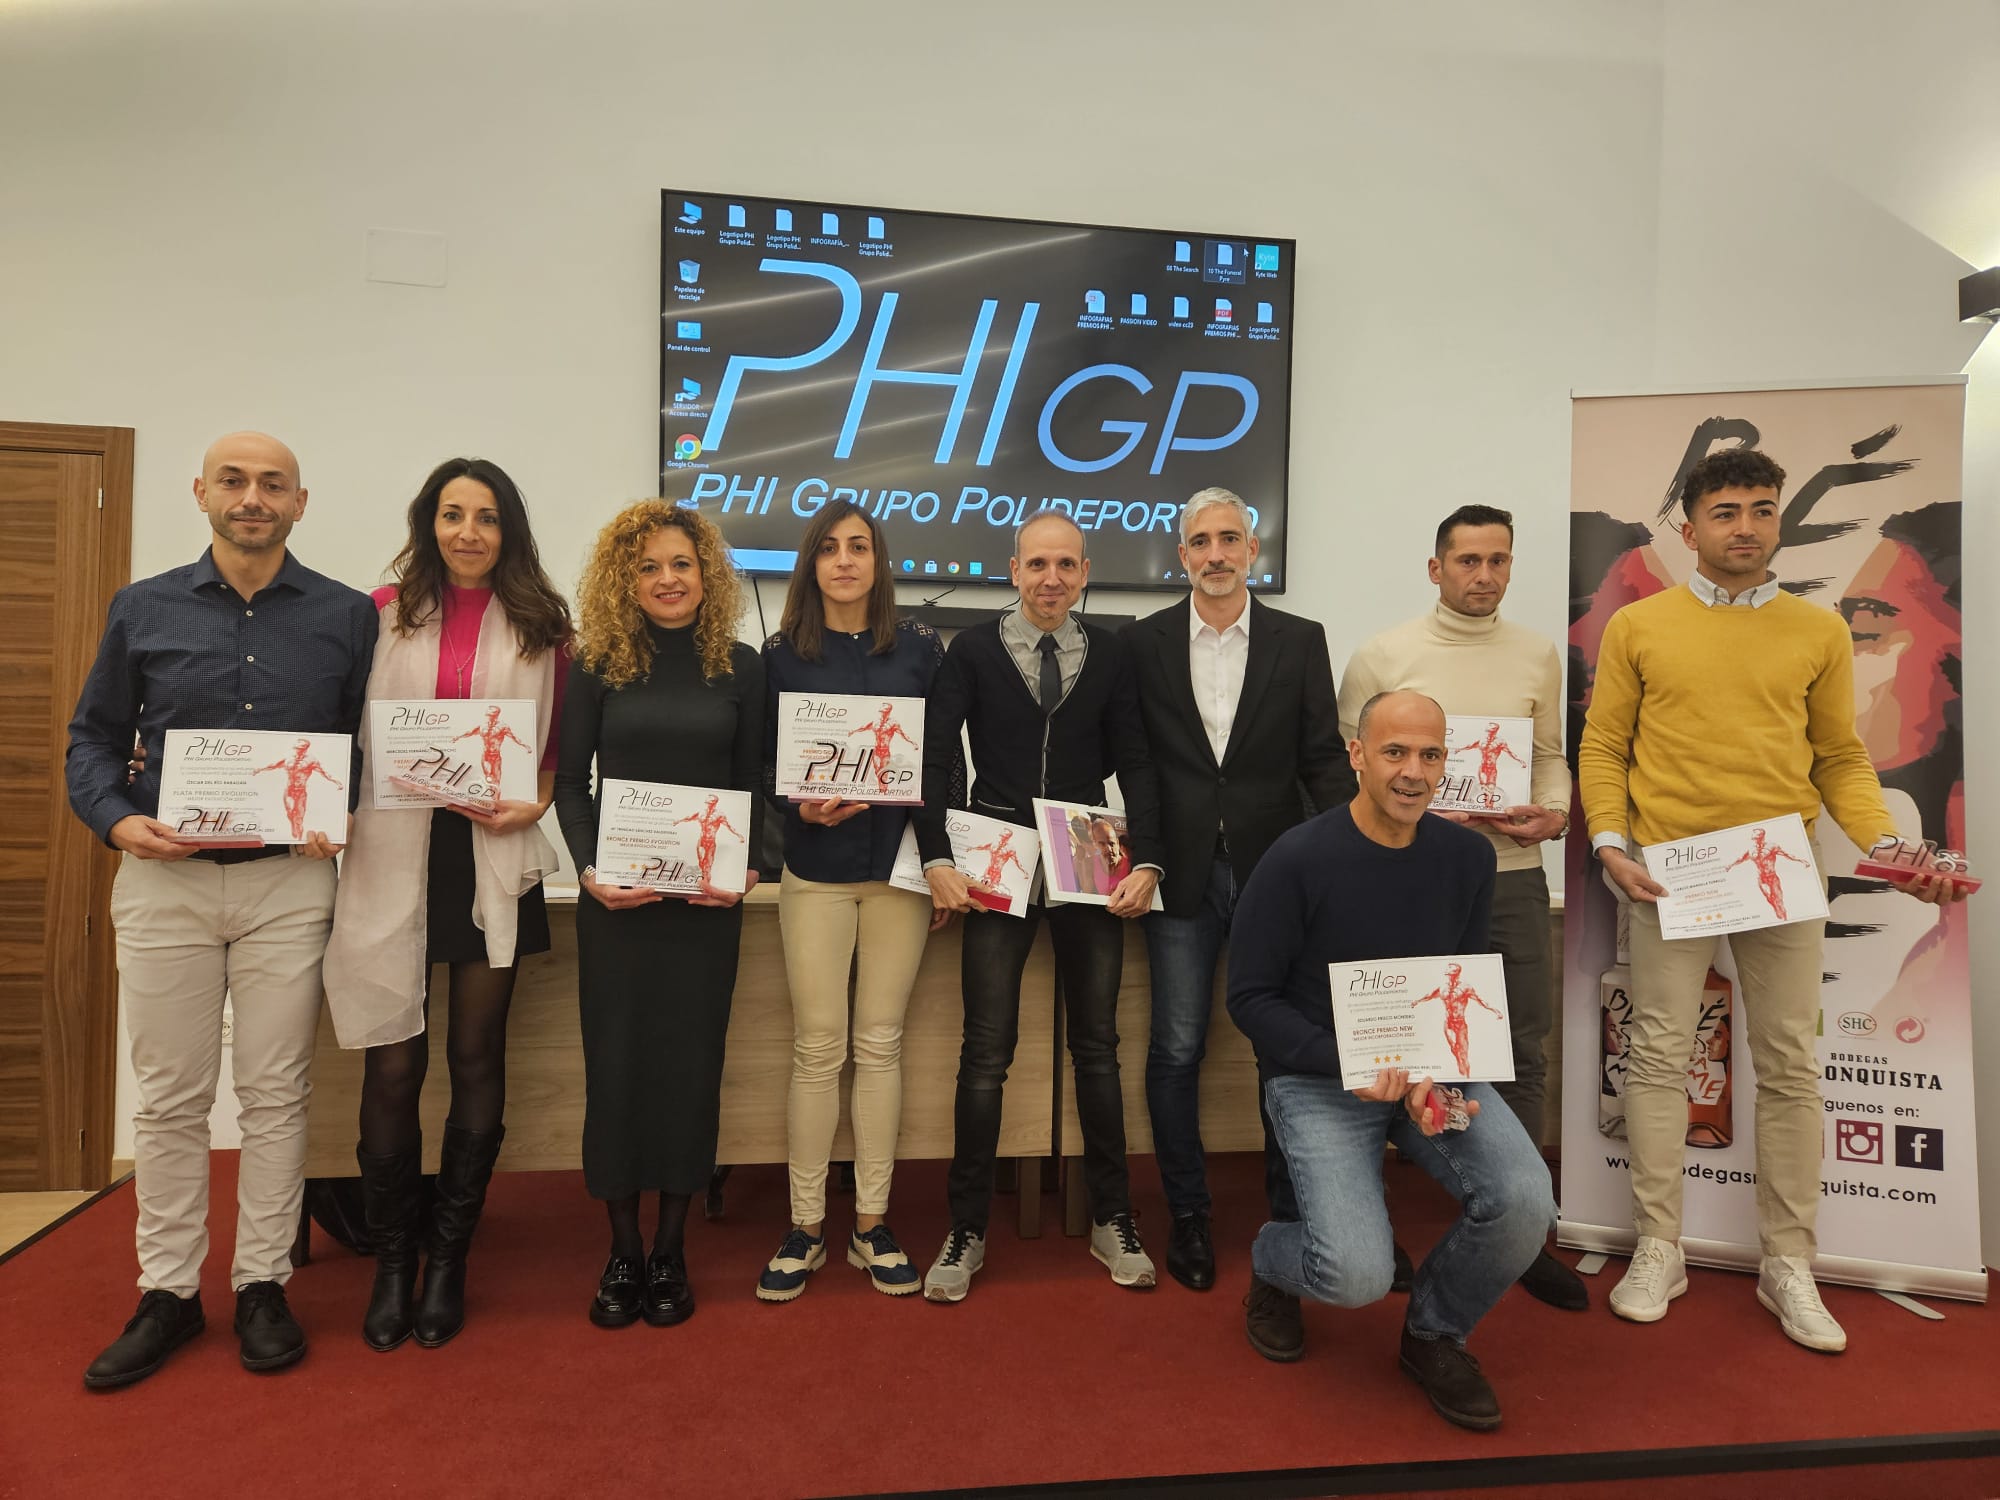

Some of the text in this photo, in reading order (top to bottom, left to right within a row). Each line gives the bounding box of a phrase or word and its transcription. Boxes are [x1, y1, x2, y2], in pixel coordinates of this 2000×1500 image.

[674, 226, 705, 236] Este equipo
[674, 286, 696, 294] Papelera
[678, 293, 700, 302] reciclaje
[667, 344, 711, 353] Panel de control
[702, 258, 1260, 475] PHI GP
[667, 460, 686, 469] Google
[690, 473, 779, 515] PHI
[390, 706, 450, 726] PHI GP
[796, 700, 847, 718] PHI GP
[186, 736, 252, 756] PHI GP
[410, 746, 496, 797] PHI GP
[804, 742, 913, 785] PHI GP
[620, 787, 673, 807] PHI GP
[798, 786, 817, 794] PHI
[818, 786, 848, 795] GRUPO
[1476, 793, 1501, 804] GP
[178, 808, 230, 832] PHI
[232, 824, 257, 833] GP
[950, 822, 971, 833] GP
[1666, 846, 1718, 867] PHI GP
[1870, 834, 1932, 867] PHI
[642, 858, 683, 881] PHI
[1350, 969, 1407, 991] PHI GP
[1842, 1017, 1872, 1030] SHC
[1831, 1052, 1888, 1065] BODEGAS
[1821, 1066, 1943, 1090] ONQUISTA
[1894, 1106, 1919, 1117] en:
